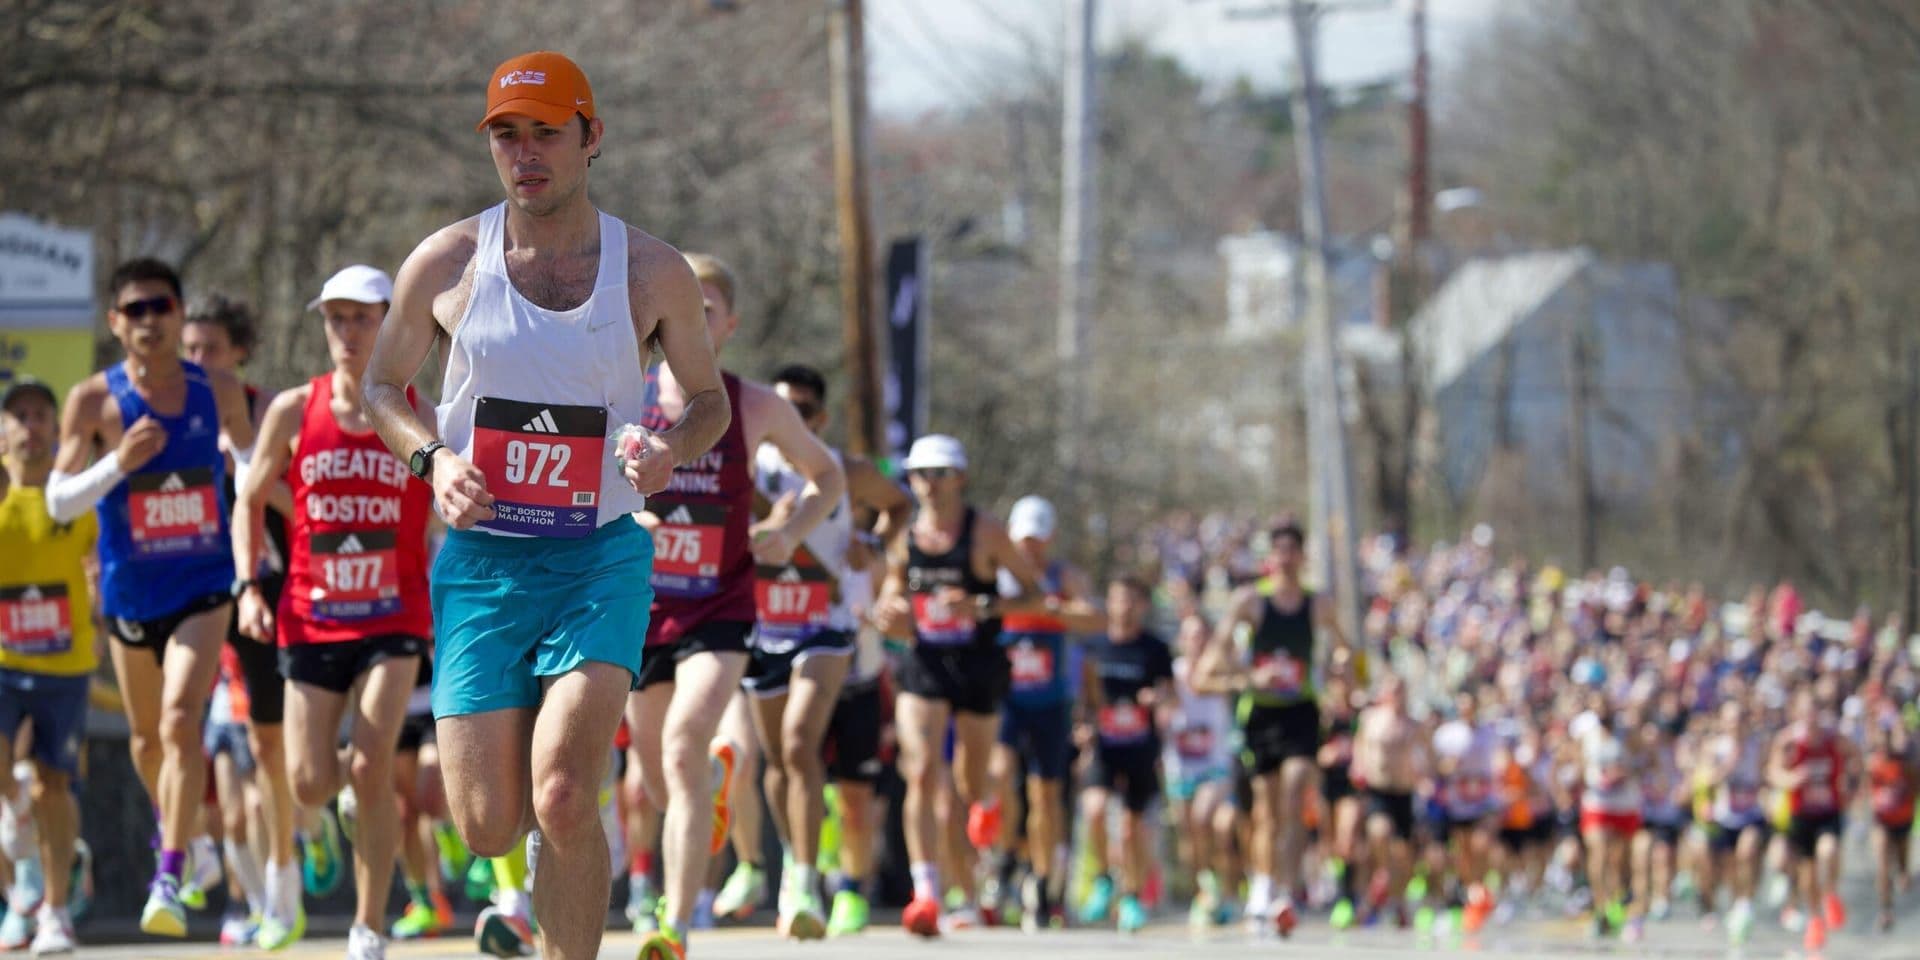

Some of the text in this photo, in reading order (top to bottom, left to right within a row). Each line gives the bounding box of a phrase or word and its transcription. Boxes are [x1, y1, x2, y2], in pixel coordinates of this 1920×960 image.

[301, 447, 409, 492] GREATER
[505, 439, 572, 488] 972
[306, 492, 402, 522] BOSTON
[498, 511, 554, 526] MARATHON
[517, 507, 555, 518] BOSTON
[655, 527, 701, 564] 575
[323, 555, 384, 592] 1877
